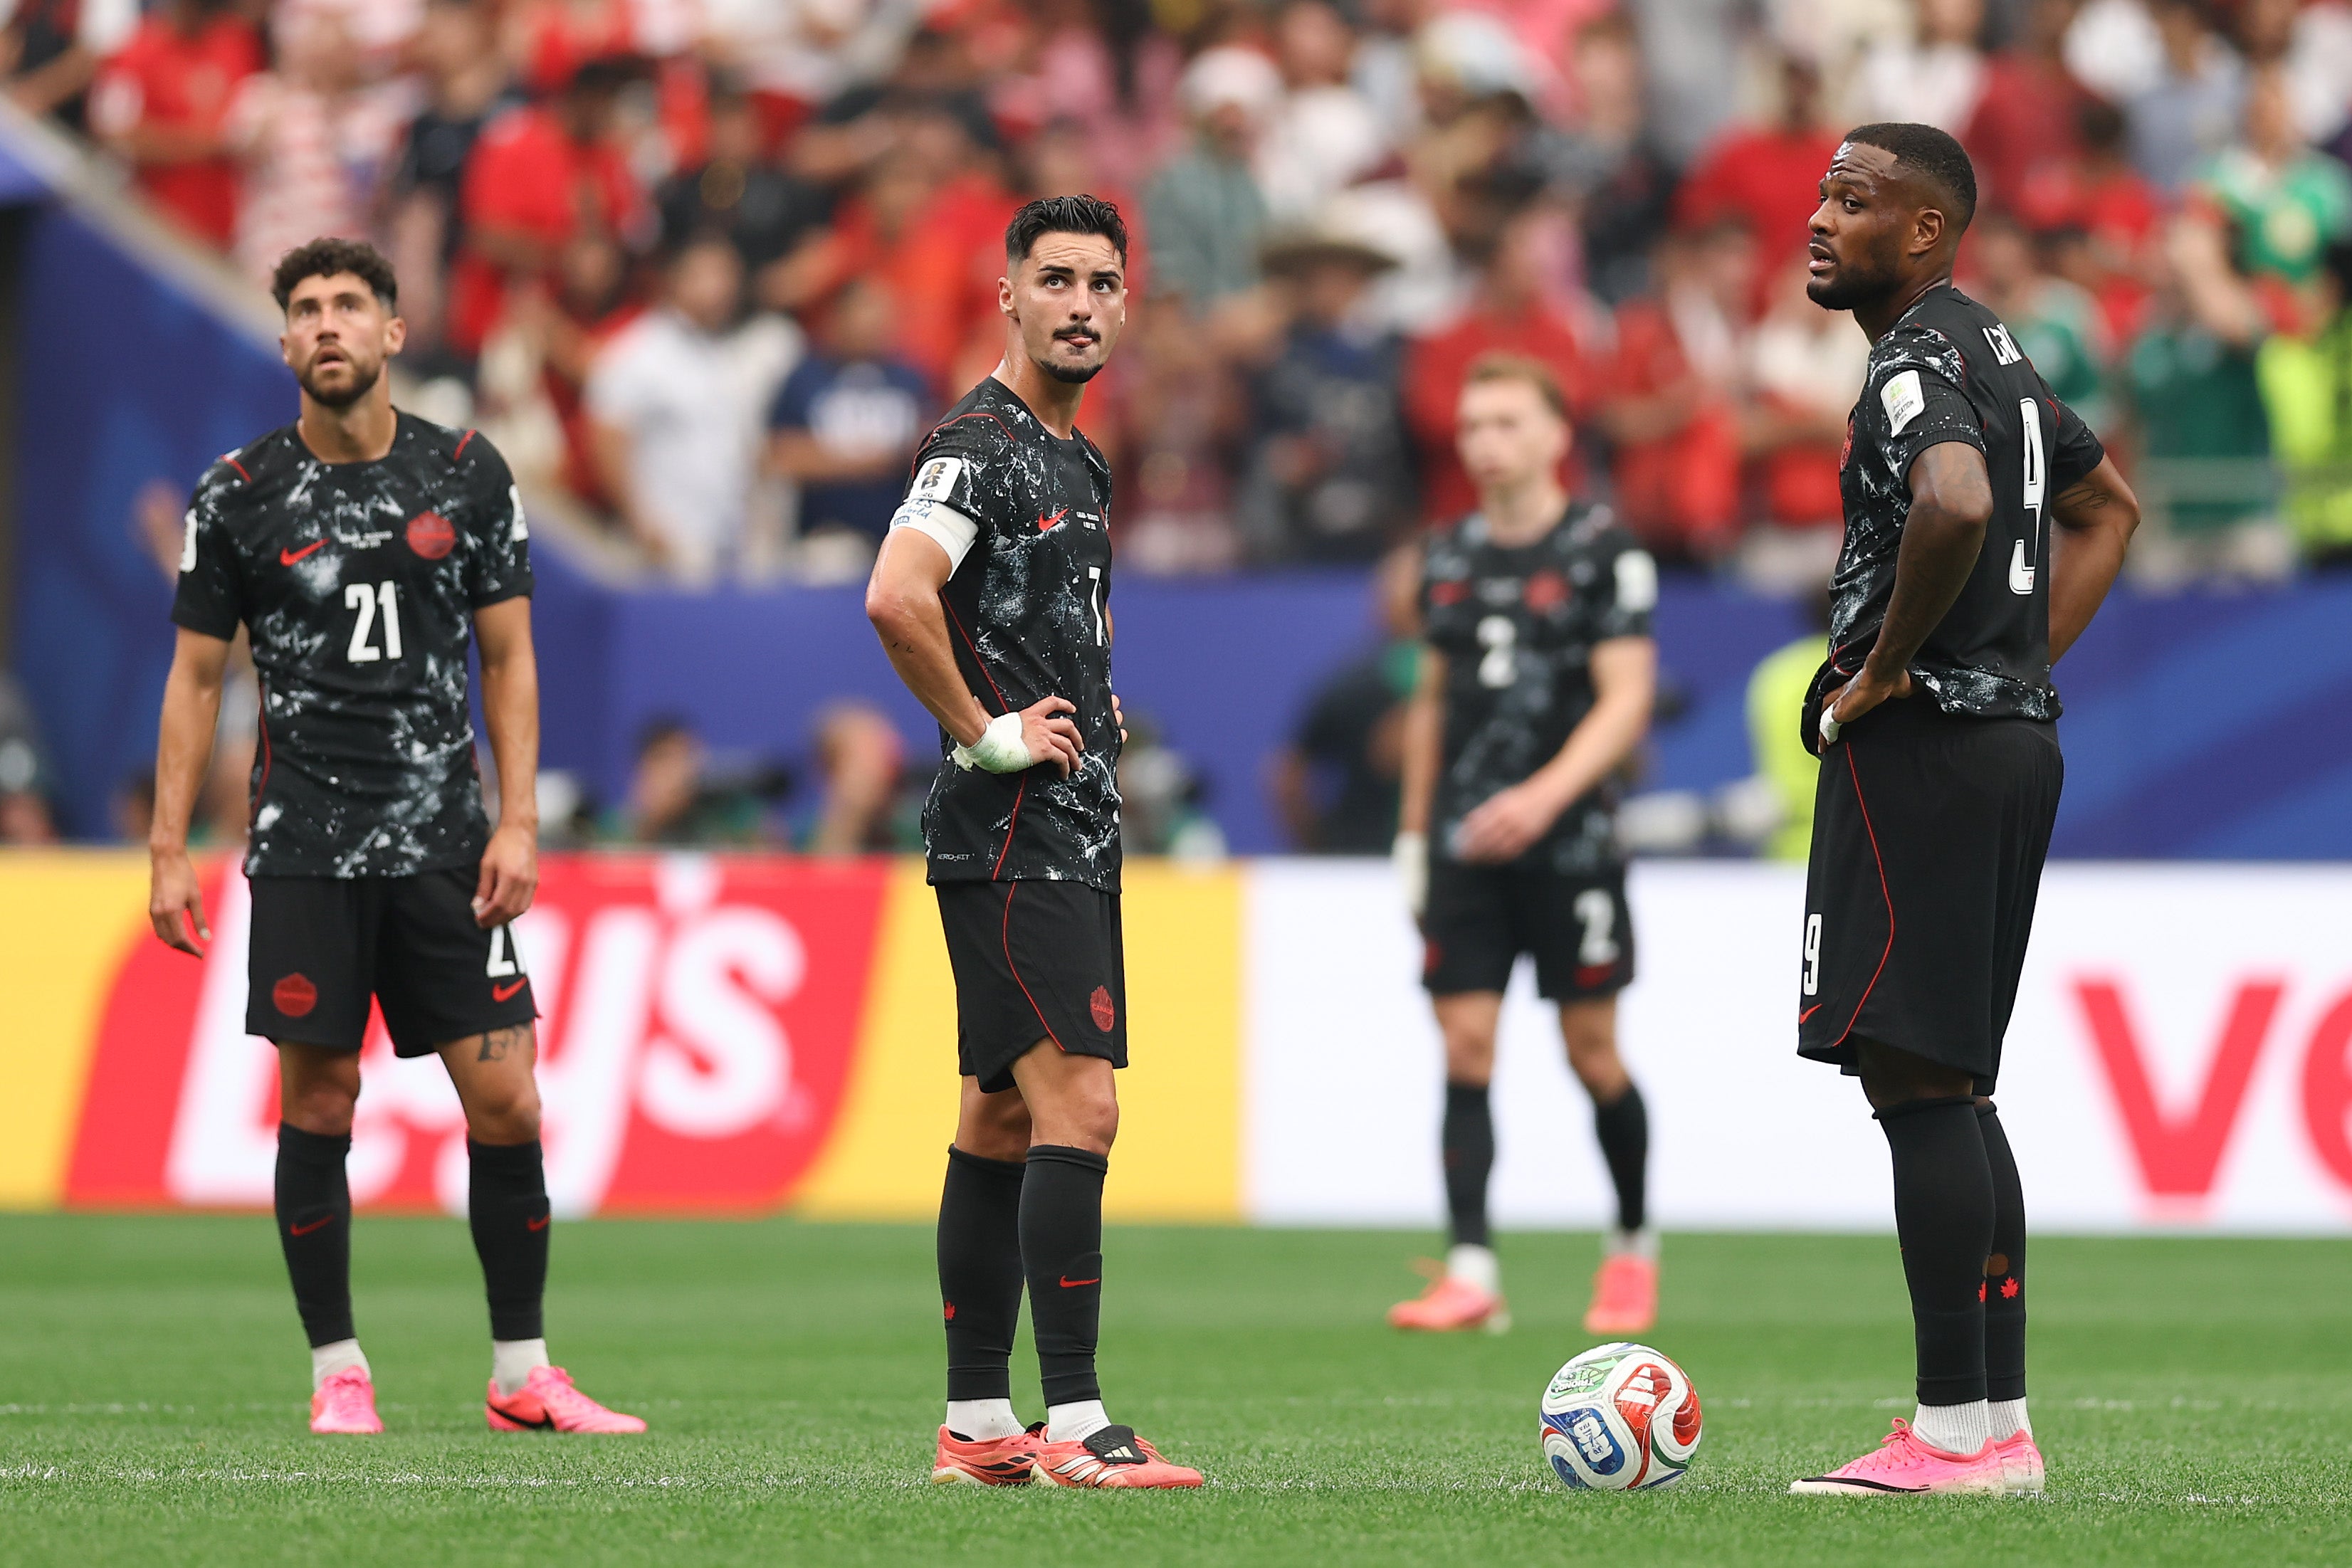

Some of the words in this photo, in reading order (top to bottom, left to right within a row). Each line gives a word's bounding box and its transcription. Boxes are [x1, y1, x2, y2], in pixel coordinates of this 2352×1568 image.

[2009, 397, 2045, 595] 9
[345, 580, 402, 663] 21
[1088, 567, 1103, 646] 7
[1476, 614, 1516, 688] 2
[1573, 888, 1619, 966] 2
[1803, 913, 1822, 996] 9
[162, 854, 810, 1226] Ly's
